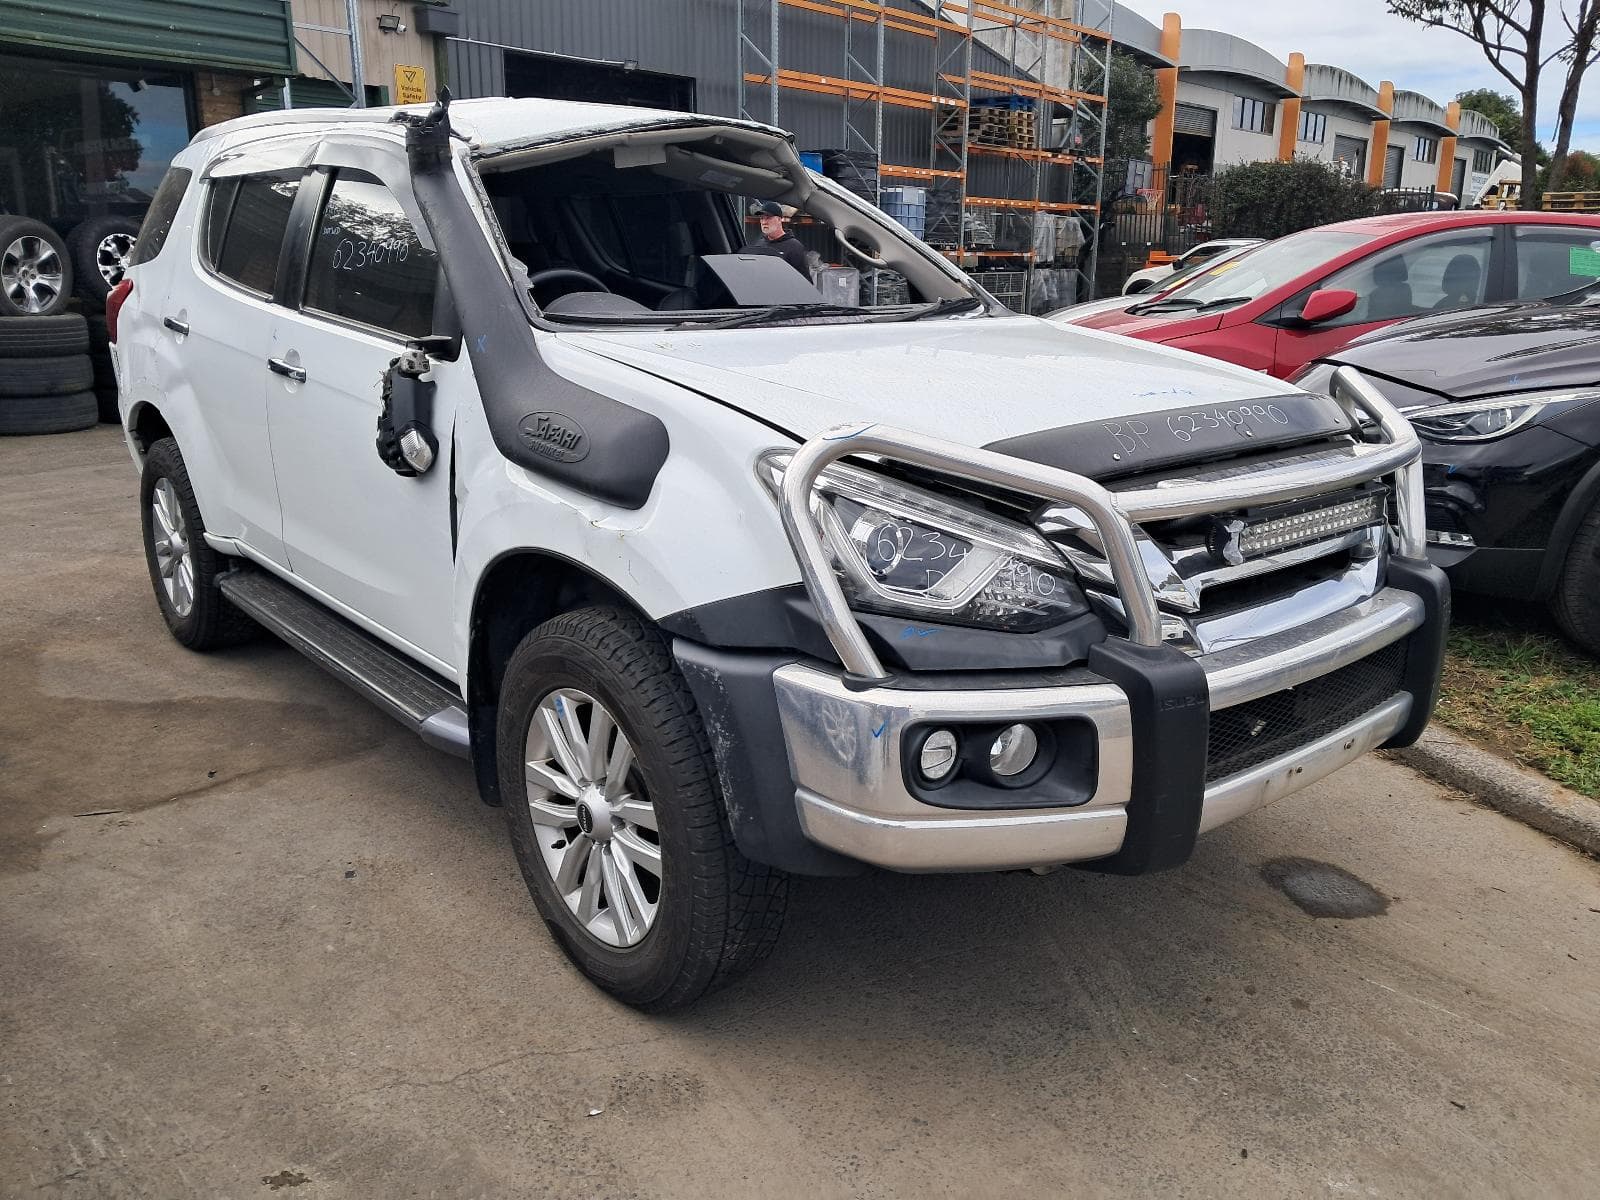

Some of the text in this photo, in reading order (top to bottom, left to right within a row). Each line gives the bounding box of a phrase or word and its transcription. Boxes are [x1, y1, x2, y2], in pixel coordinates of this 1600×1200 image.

[402, 92, 422, 101] Safety
[525, 415, 582, 450] SAFARI
[1102, 405, 1289, 456] BP 62340990
